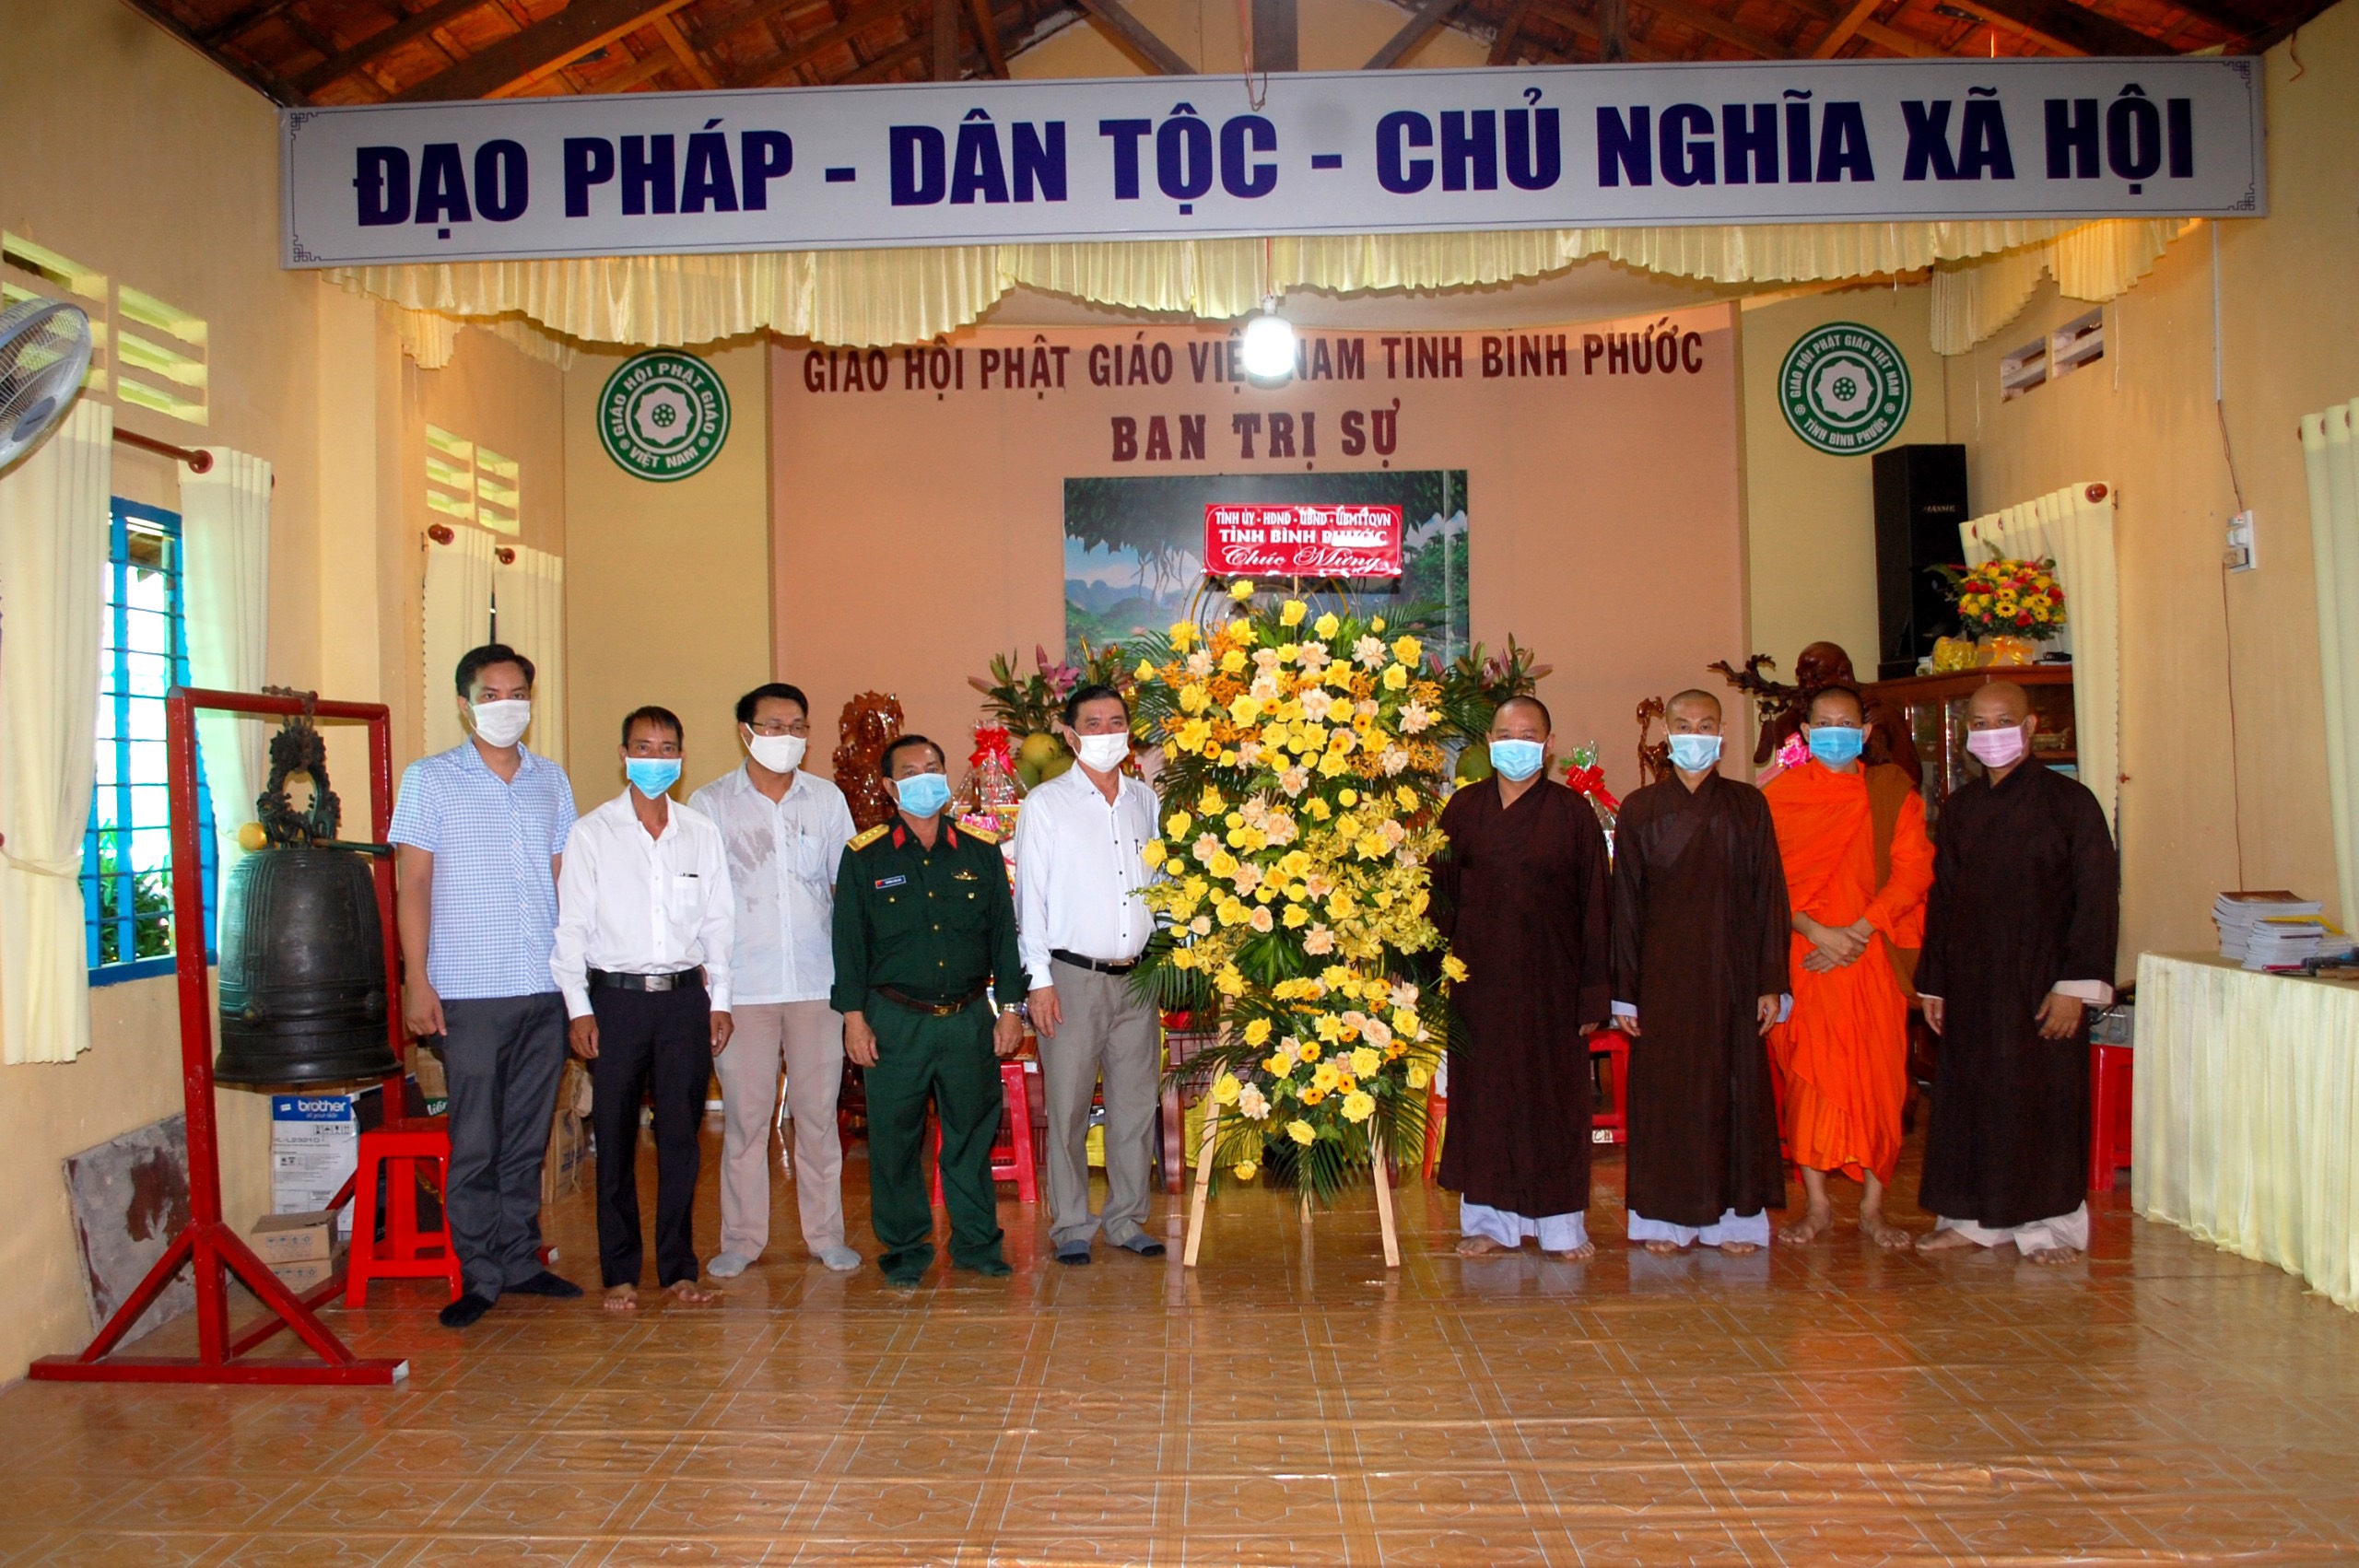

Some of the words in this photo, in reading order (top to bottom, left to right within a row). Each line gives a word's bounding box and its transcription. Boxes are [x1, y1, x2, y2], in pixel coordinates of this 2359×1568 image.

[353, 138, 529, 240] ĐẠO
[563, 118, 793, 218] PHÁP
[825, 167, 856, 183] -
[889, 108, 1067, 206] DÂN
[1098, 102, 1278, 215] TỘC
[1311, 154, 1343, 170] -
[1375, 88, 1561, 194] CHỦ
[1596, 88, 1875, 187] NGHĨA
[1901, 86, 2015, 181] XÃ
[2044, 83, 2194, 195] HỘI
[904, 335, 964, 401] HỘI
[980, 333, 1071, 400] PHẬT
[1088, 331, 1173, 387] GIÁO
[1188, 328, 1245, 394] VIỆ
[1289, 337, 1366, 380] NAM
[1583, 316, 1703, 376] PHƯỚC
[1885, 370, 1900, 396] NAM
[608, 393, 627, 437] GIÁO
[1111, 414, 1206, 462] BAN
[1232, 412, 1317, 471] TRỊ
[1341, 397, 1401, 469] SỰ
[1828, 431, 1855, 446] BÌNH
[629, 446, 660, 468] VIỆT
[665, 446, 698, 468] NAM
[1215, 508, 1239, 525] TỈNH
[1300, 510, 1327, 525] UBND
[1219, 525, 1265, 543] TỈNH
[1270, 528, 1316, 544] BÌNH
[1222, 544, 1286, 566] Chúc
[1293, 546, 1381, 573] Mừng
[298, 1100, 346, 1112] brother
